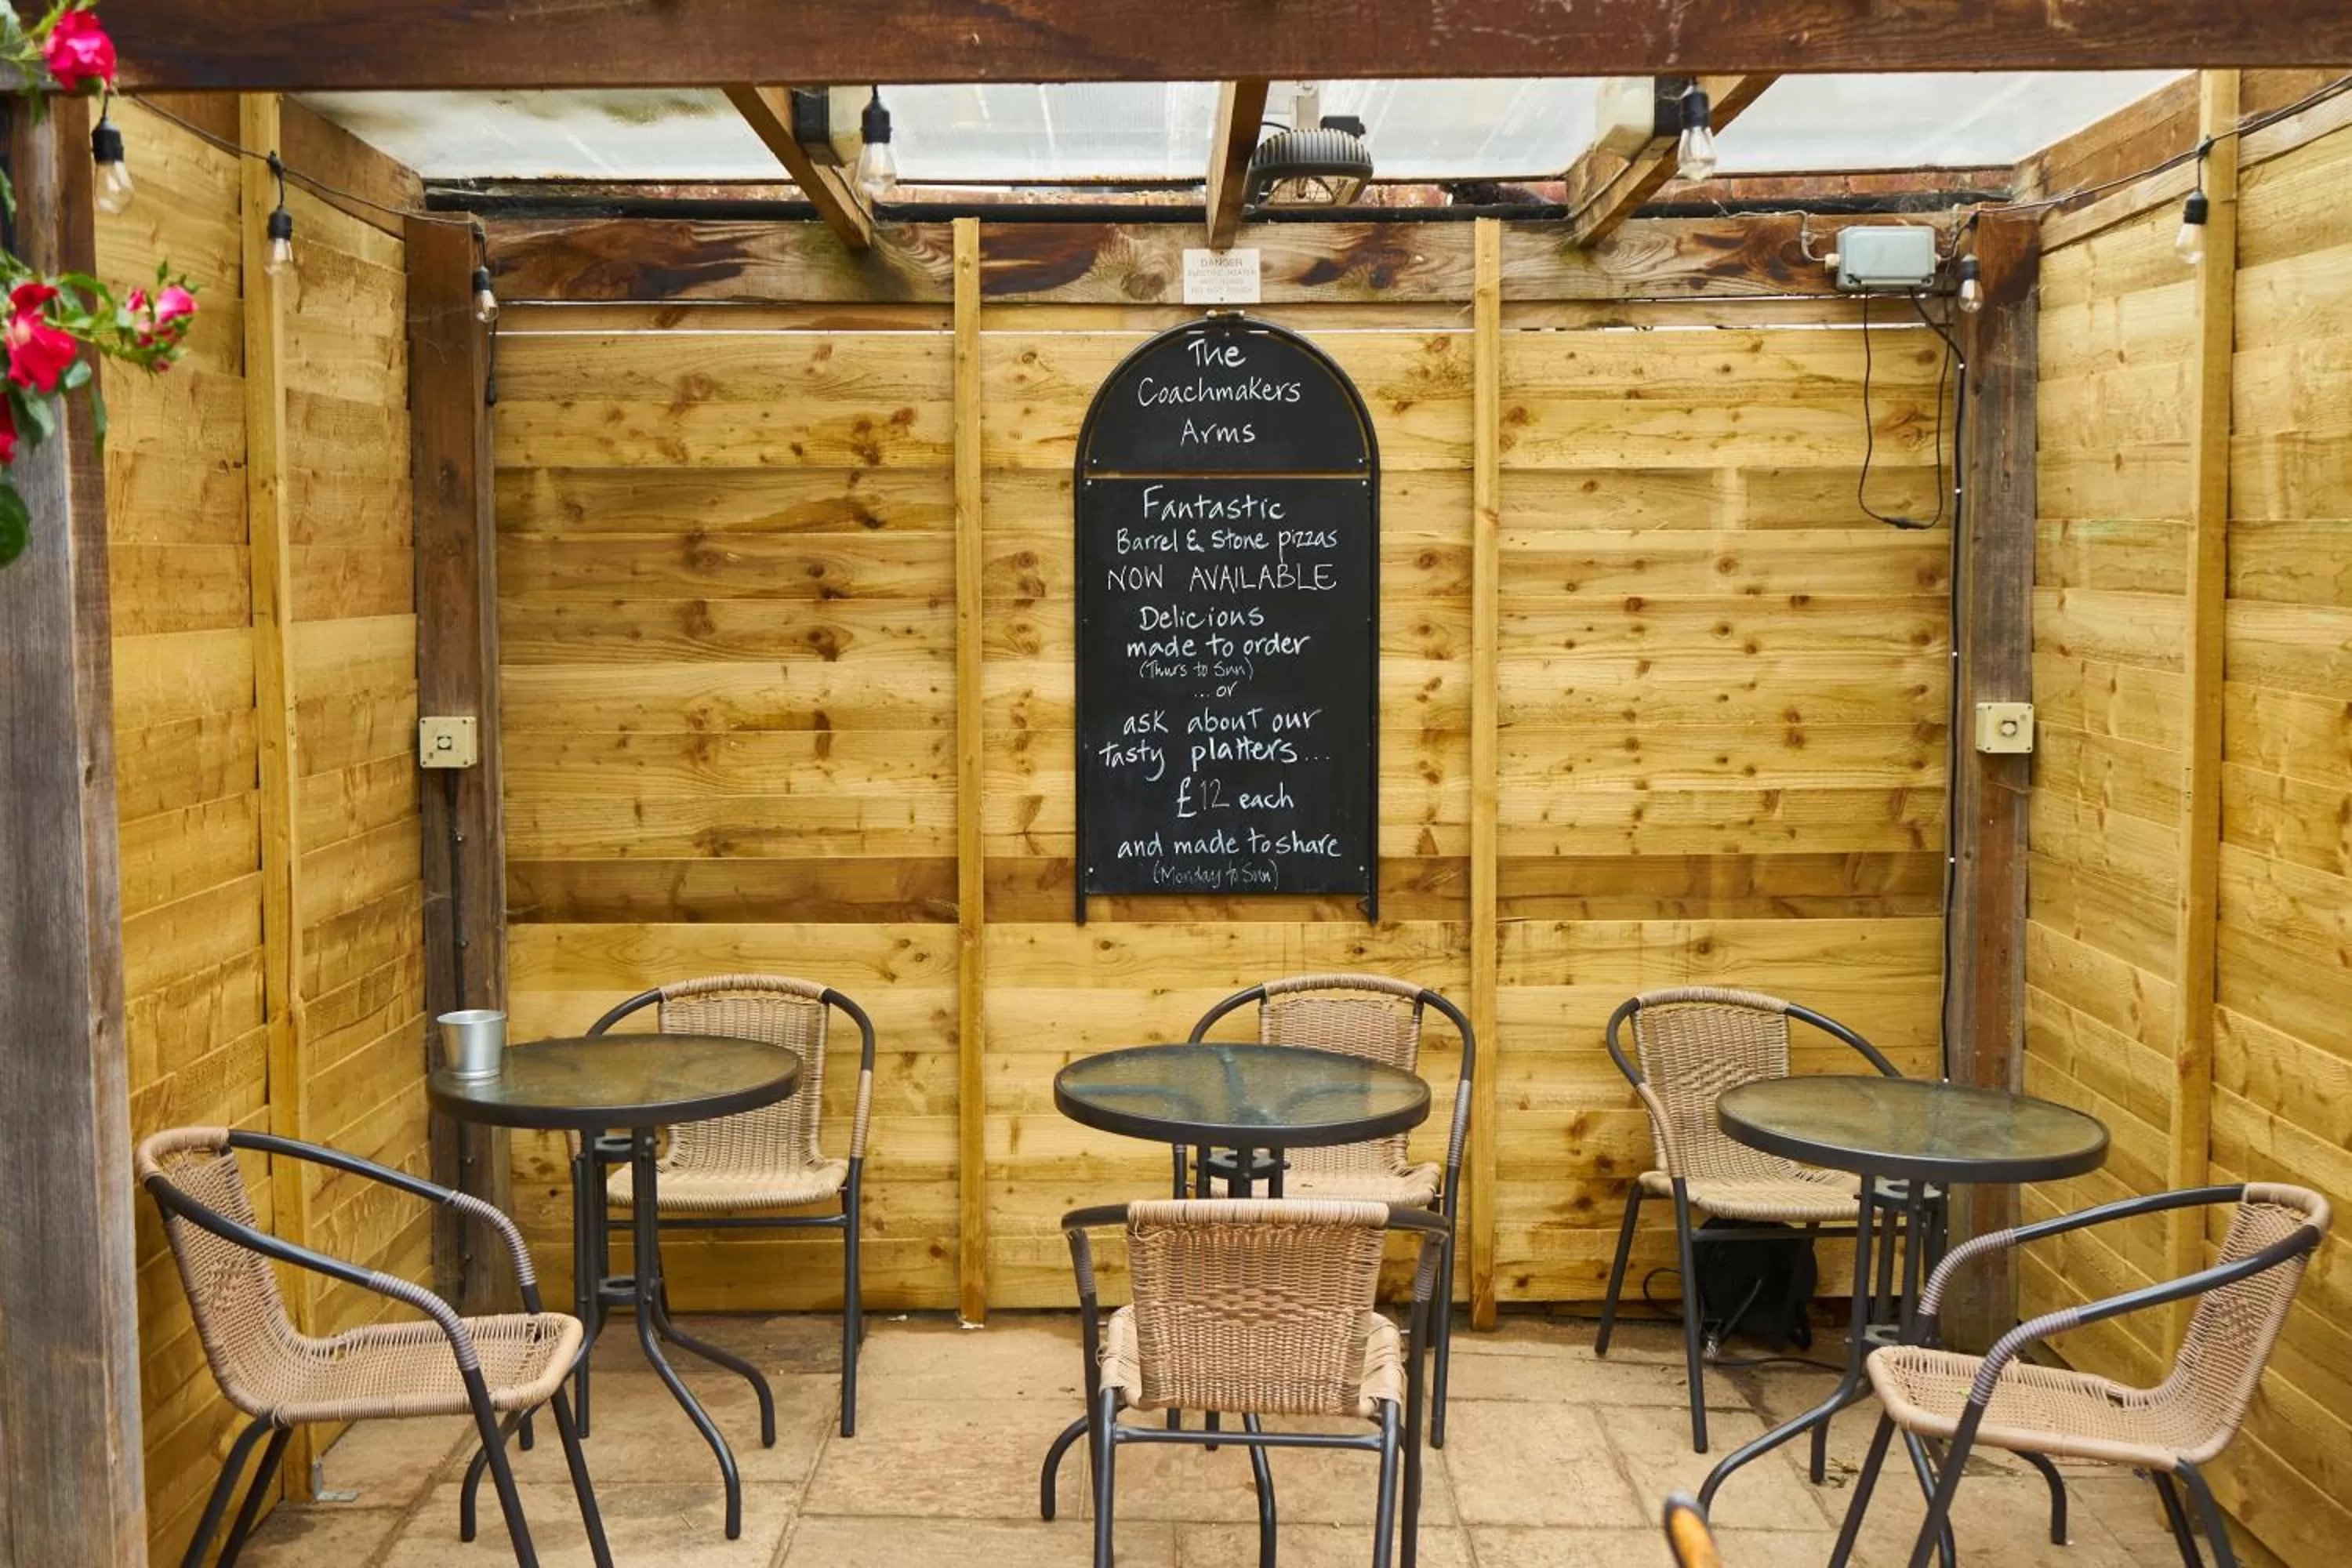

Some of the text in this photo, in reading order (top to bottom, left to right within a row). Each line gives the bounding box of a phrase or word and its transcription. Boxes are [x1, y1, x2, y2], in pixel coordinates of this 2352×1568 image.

[1200, 256, 1243, 267] DANGER
[1188, 339, 1247, 367] The
[1138, 376, 1301, 406] Coachmakers
[1181, 418, 1255, 447] Arms
[1143, 485, 1286, 521] Fantastic
[1117, 528, 1178, 554] Barrel
[1186, 530, 1204, 552] &
[1279, 529, 1338, 564] pizzas
[1108, 561, 1337, 593] NOW AVAILABLE
[1139, 604, 1264, 630] Delicious
[1127, 632, 1311, 660] made to order
[1194, 662, 1207, 677] to
[1123, 706, 1322, 735] ask about our
[1240, 781, 1294, 809] each
[1117, 831, 1163, 858] and
[1174, 829, 1240, 855] made
